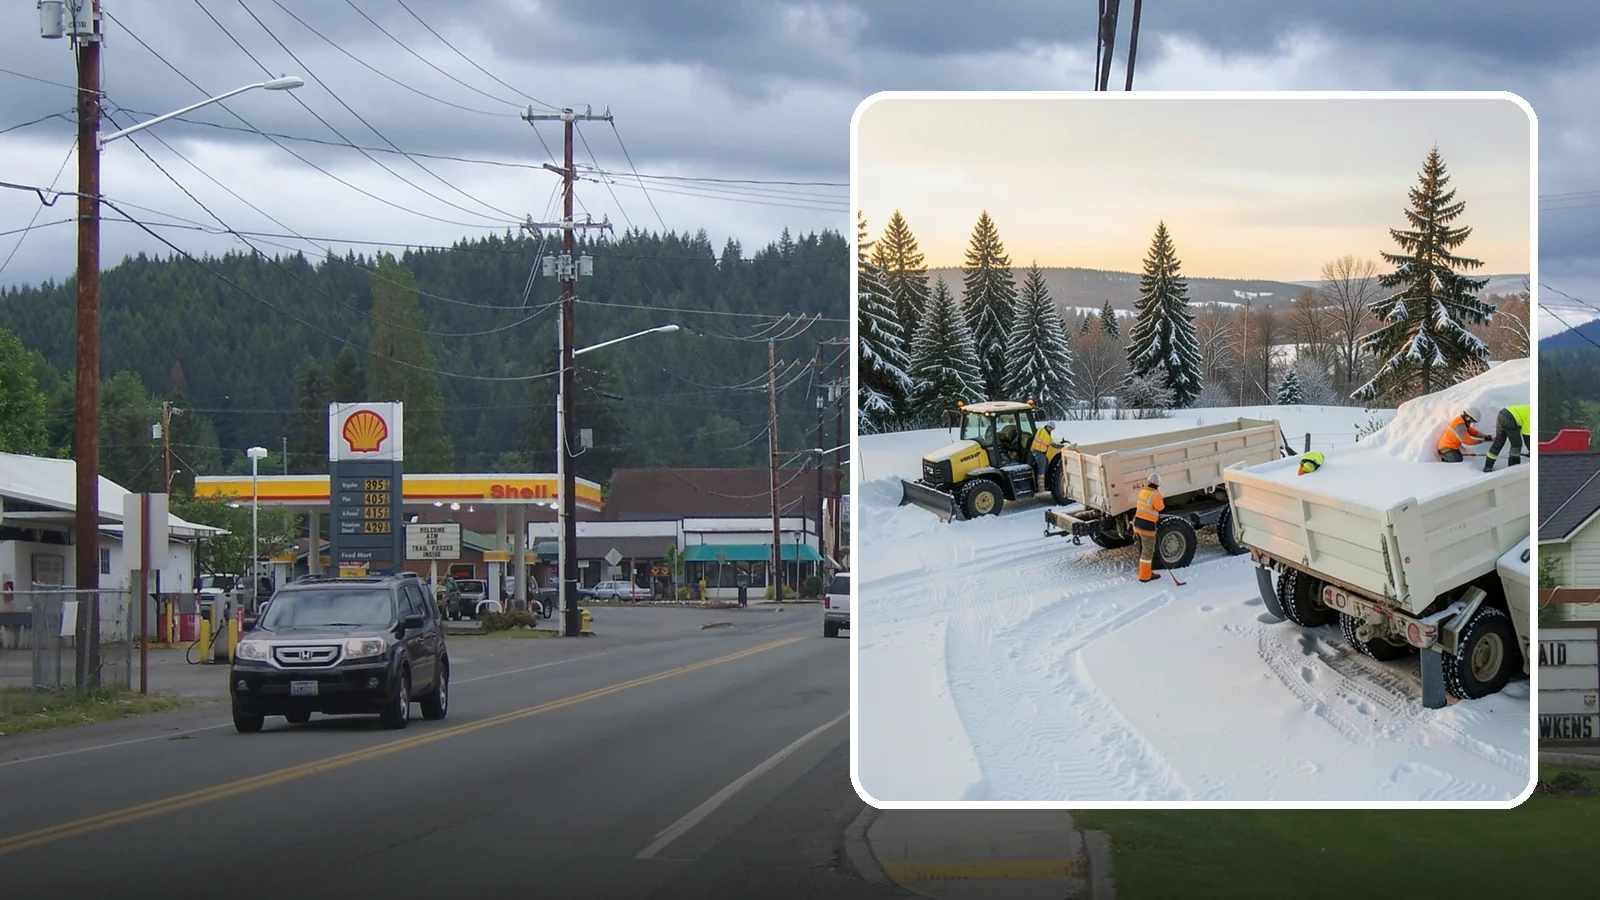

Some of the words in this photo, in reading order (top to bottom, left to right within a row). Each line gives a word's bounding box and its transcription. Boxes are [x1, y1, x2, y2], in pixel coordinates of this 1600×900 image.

[365, 480, 384, 490] 395
[490, 484, 547, 499] Shell
[365, 494, 384, 504] 405
[365, 508, 384, 518] 415
[365, 522, 384, 532] 429
[1538, 643, 1566, 666] AID
